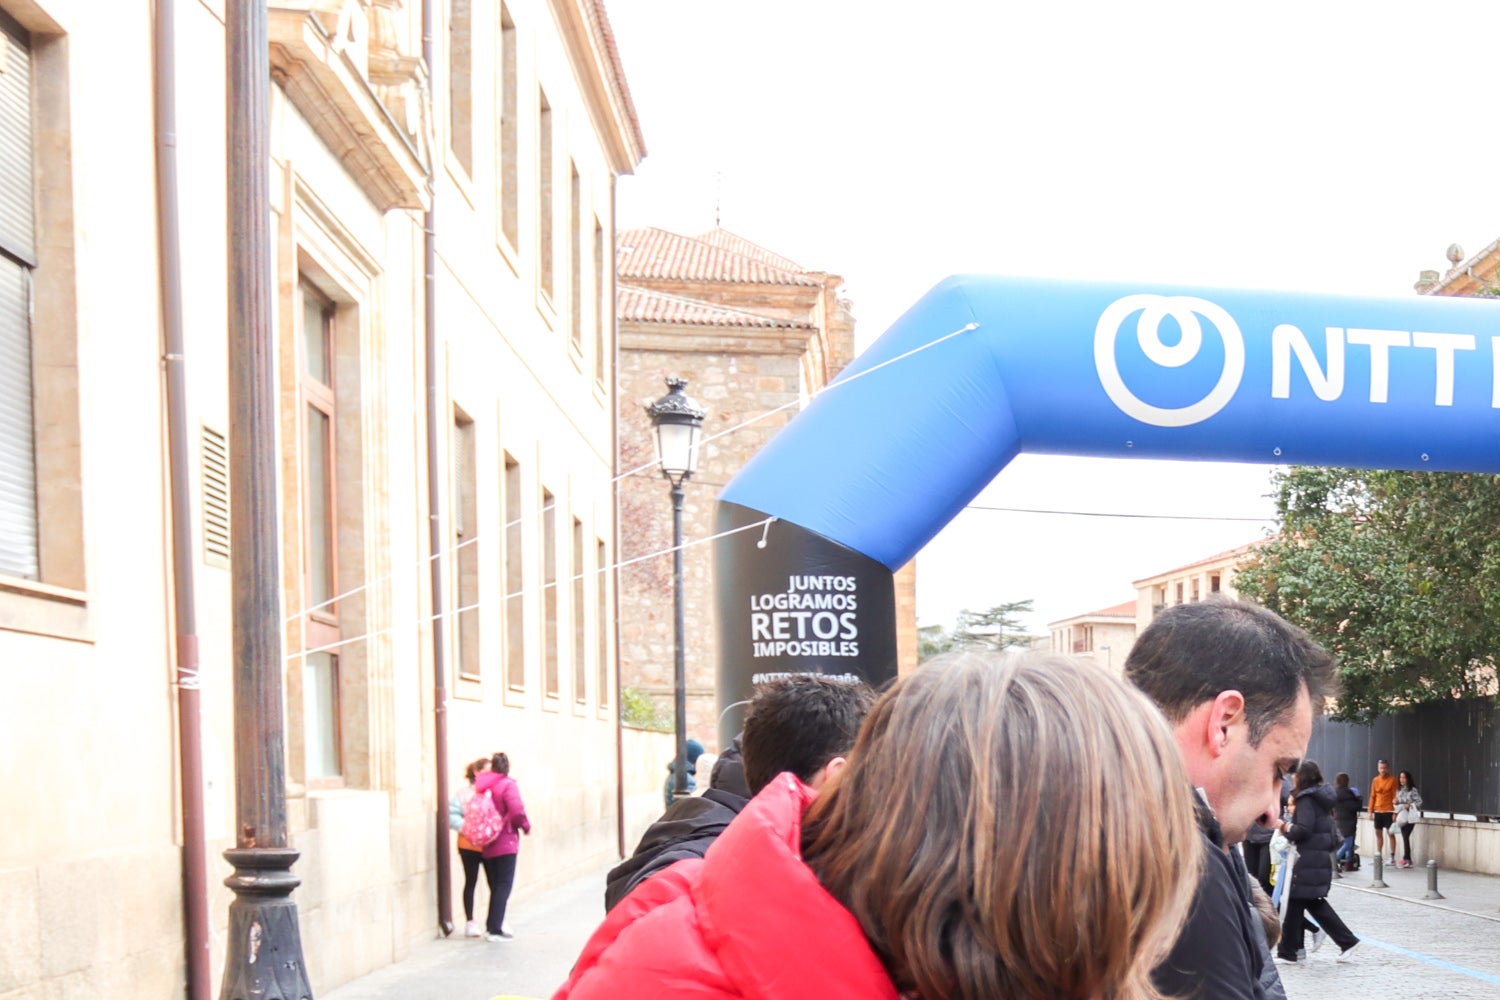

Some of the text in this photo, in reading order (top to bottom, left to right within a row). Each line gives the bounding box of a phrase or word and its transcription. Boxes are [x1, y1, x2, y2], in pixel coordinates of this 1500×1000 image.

[1271, 324, 1476, 406] NTT
[787, 575, 857, 593] JUNTOS
[751, 593, 857, 611] LOGRAMOS
[751, 612, 858, 640] RETOS
[753, 641, 859, 657] IMPOSIBLES
